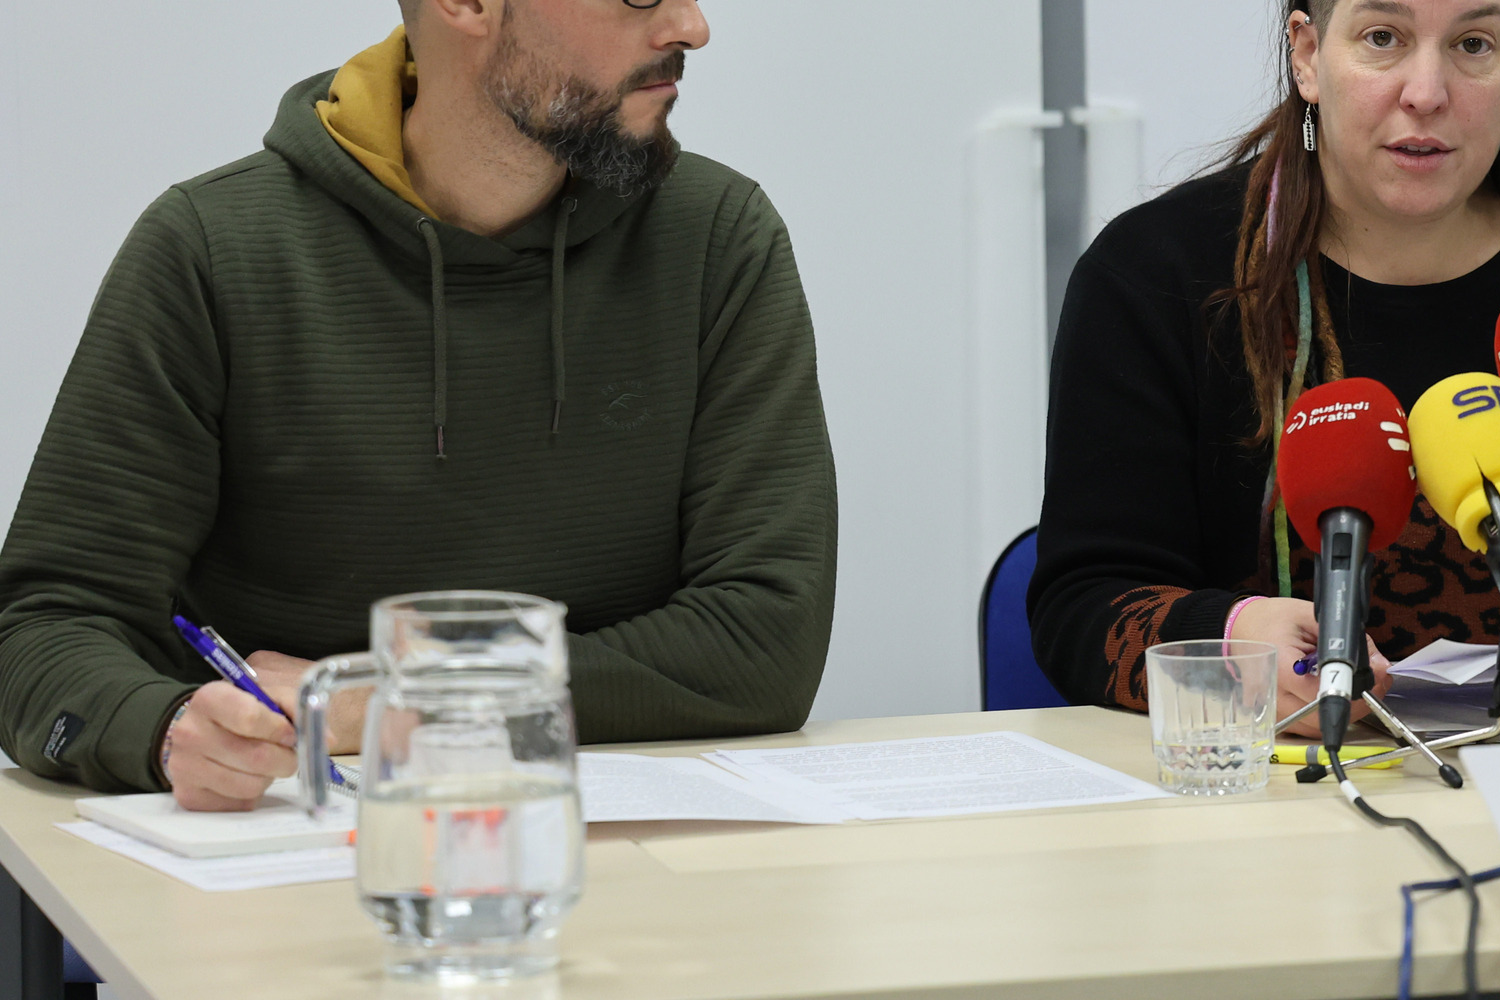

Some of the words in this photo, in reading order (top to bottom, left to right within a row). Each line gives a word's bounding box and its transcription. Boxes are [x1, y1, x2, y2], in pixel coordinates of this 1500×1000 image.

[1311, 401, 1370, 416] euskadi
[1308, 411, 1357, 426] irratia
[1328, 670, 1341, 684] 7
